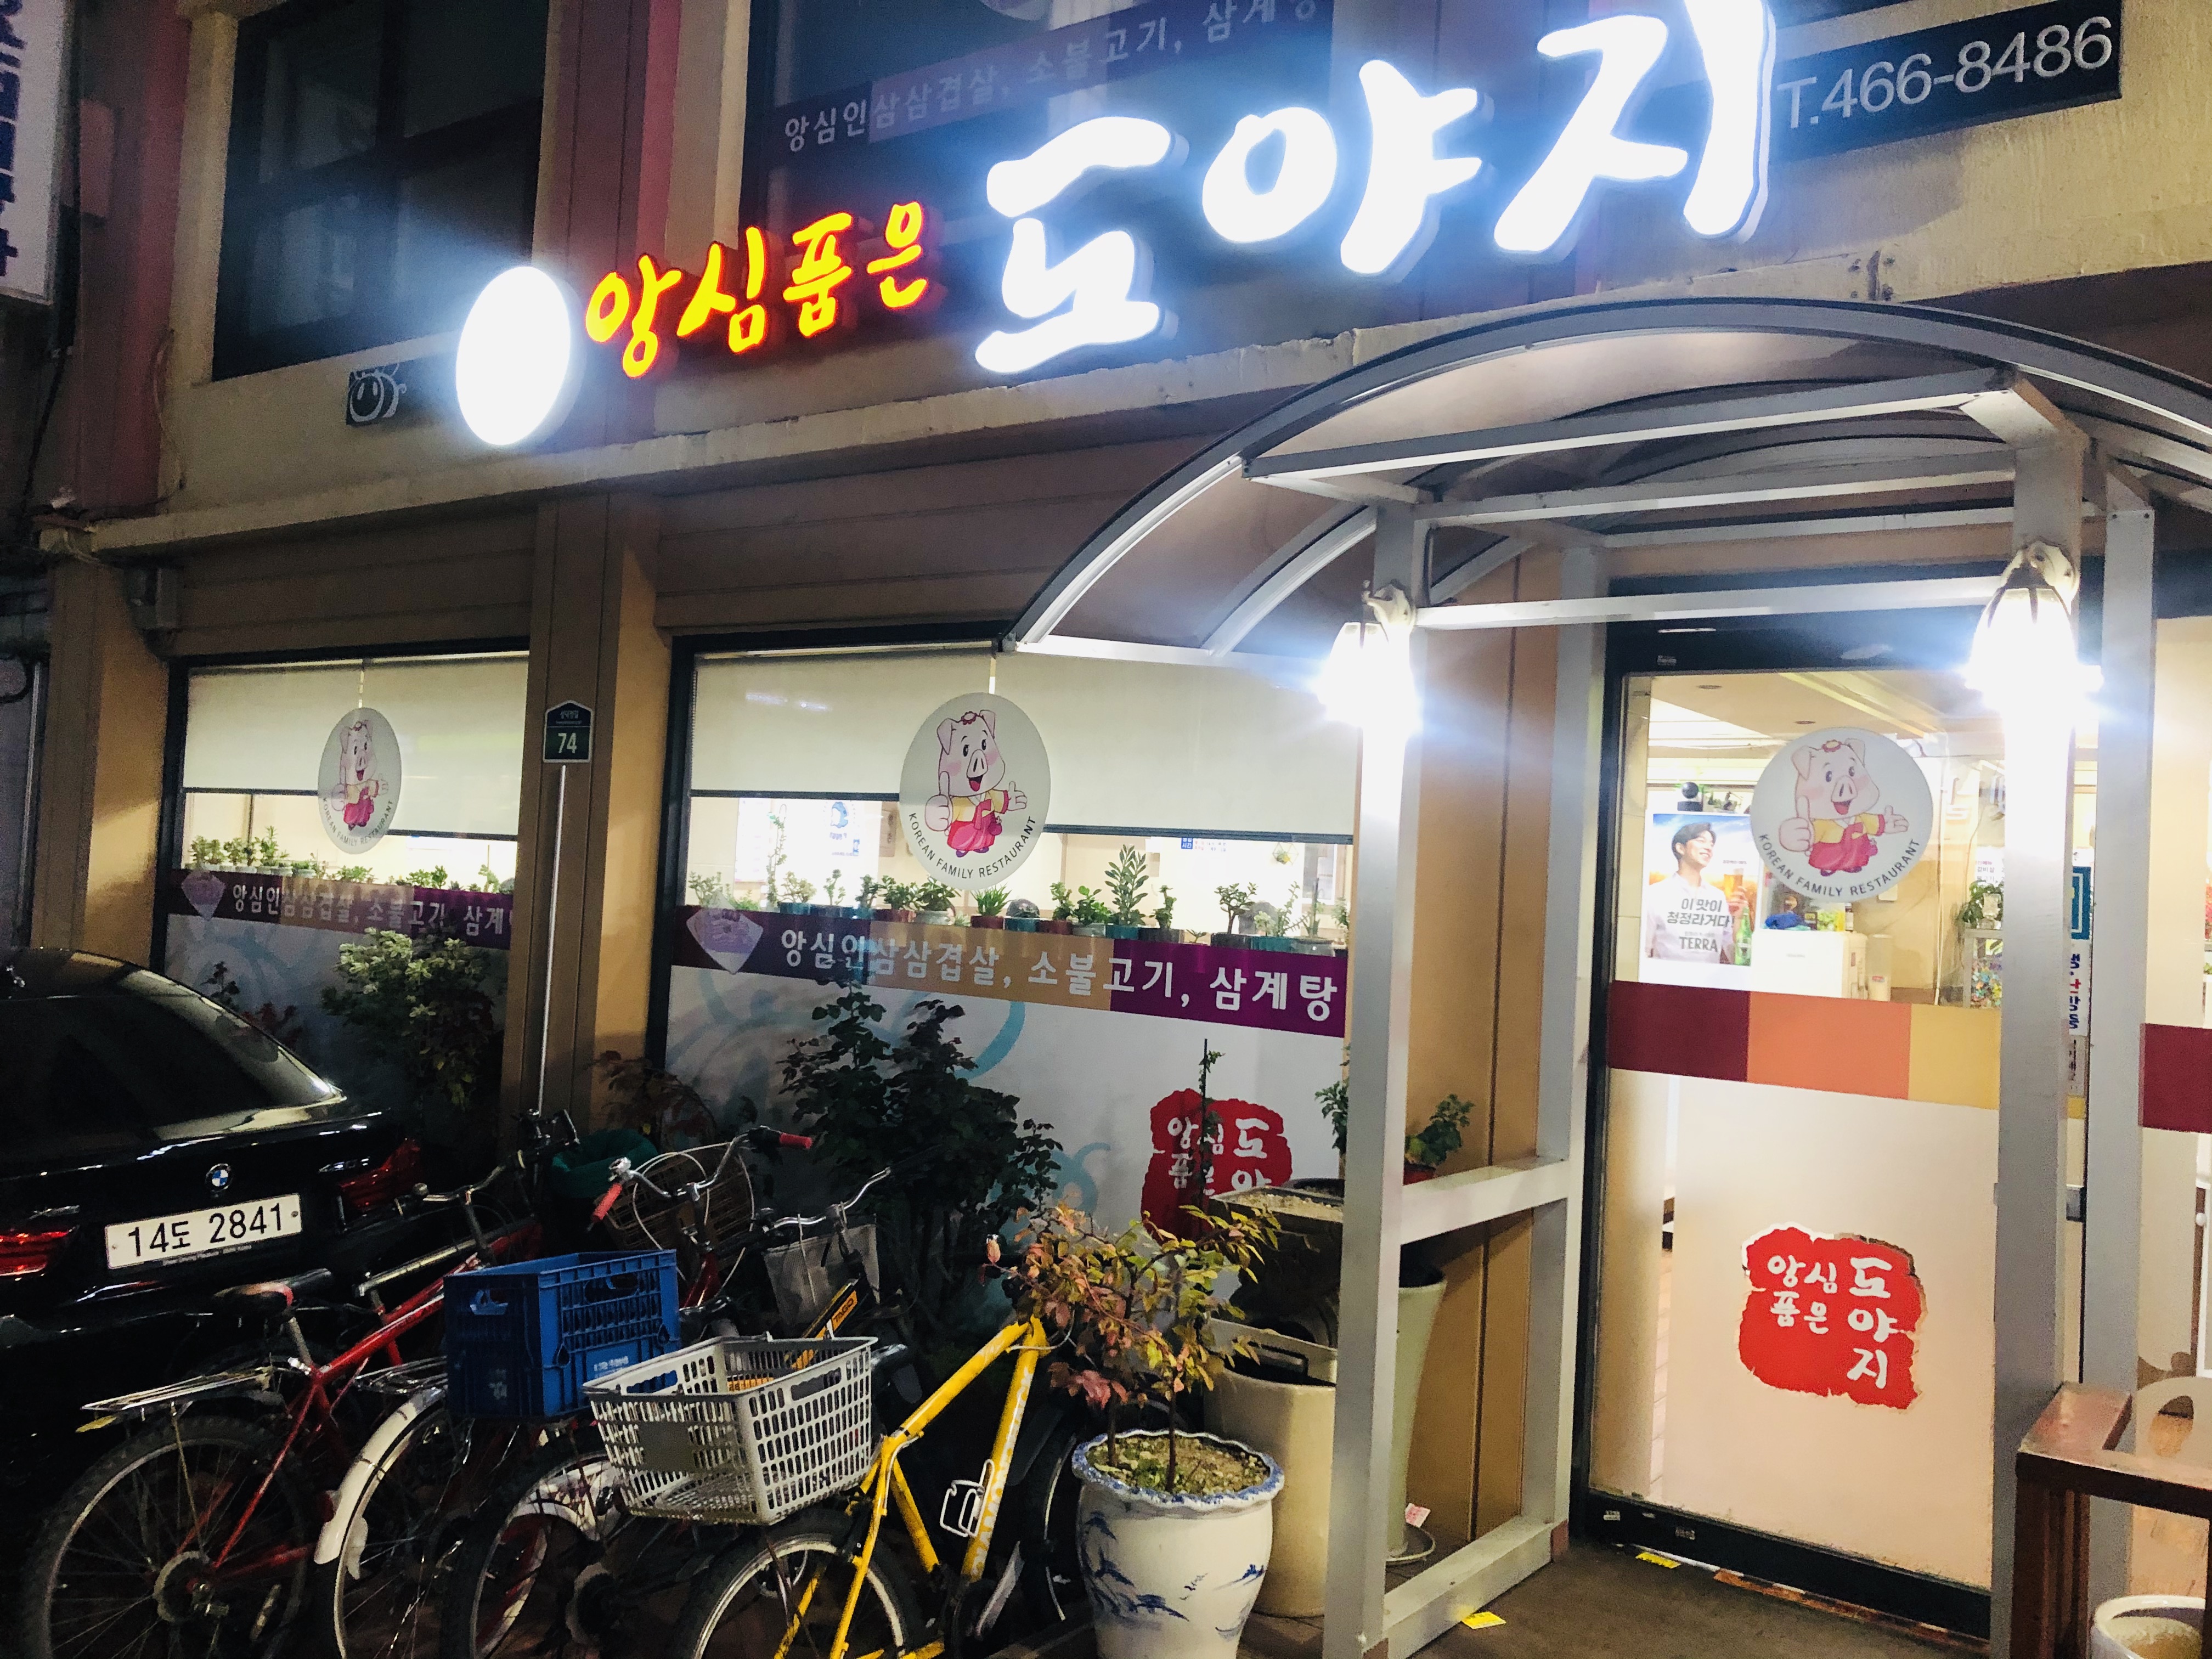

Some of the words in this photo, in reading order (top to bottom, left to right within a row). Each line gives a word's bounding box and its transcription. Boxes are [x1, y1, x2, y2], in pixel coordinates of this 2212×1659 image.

[1202, 0, 1317, 43] 삼계
[1776, 16, 2113, 129] T.466-8486
[974, 0, 1775, 374] 도야지
[557, 732, 577, 754] 74
[322, 797, 337, 834] KOREAN
[336, 828, 358, 847] FAMILY
[360, 799, 394, 845] RESTAURANT
[908, 811, 935, 862] KOREAN
[935, 857, 974, 880] FAMILY
[978, 815, 1037, 879] RESTAURANT
[1757, 833, 1793, 881] KOREAN
[1795, 875, 1844, 898] FAMILY
[1849, 838, 1921, 896] RESTAURANT
[463, 905, 513, 936] 삼계
[1666, 911, 1735, 928] 청정라거다!
[1695, 899, 1723, 913] 맛이
[1679, 936, 1719, 952] TERRA
[1028, 950, 1190, 1008] 소불고기,
[1209, 966, 1338, 1022] 삼계탕
[128, 1220, 191, 1259] 14도
[208, 1203, 284, 1244] 2841
[833, 1297, 854, 1322] TAGO
